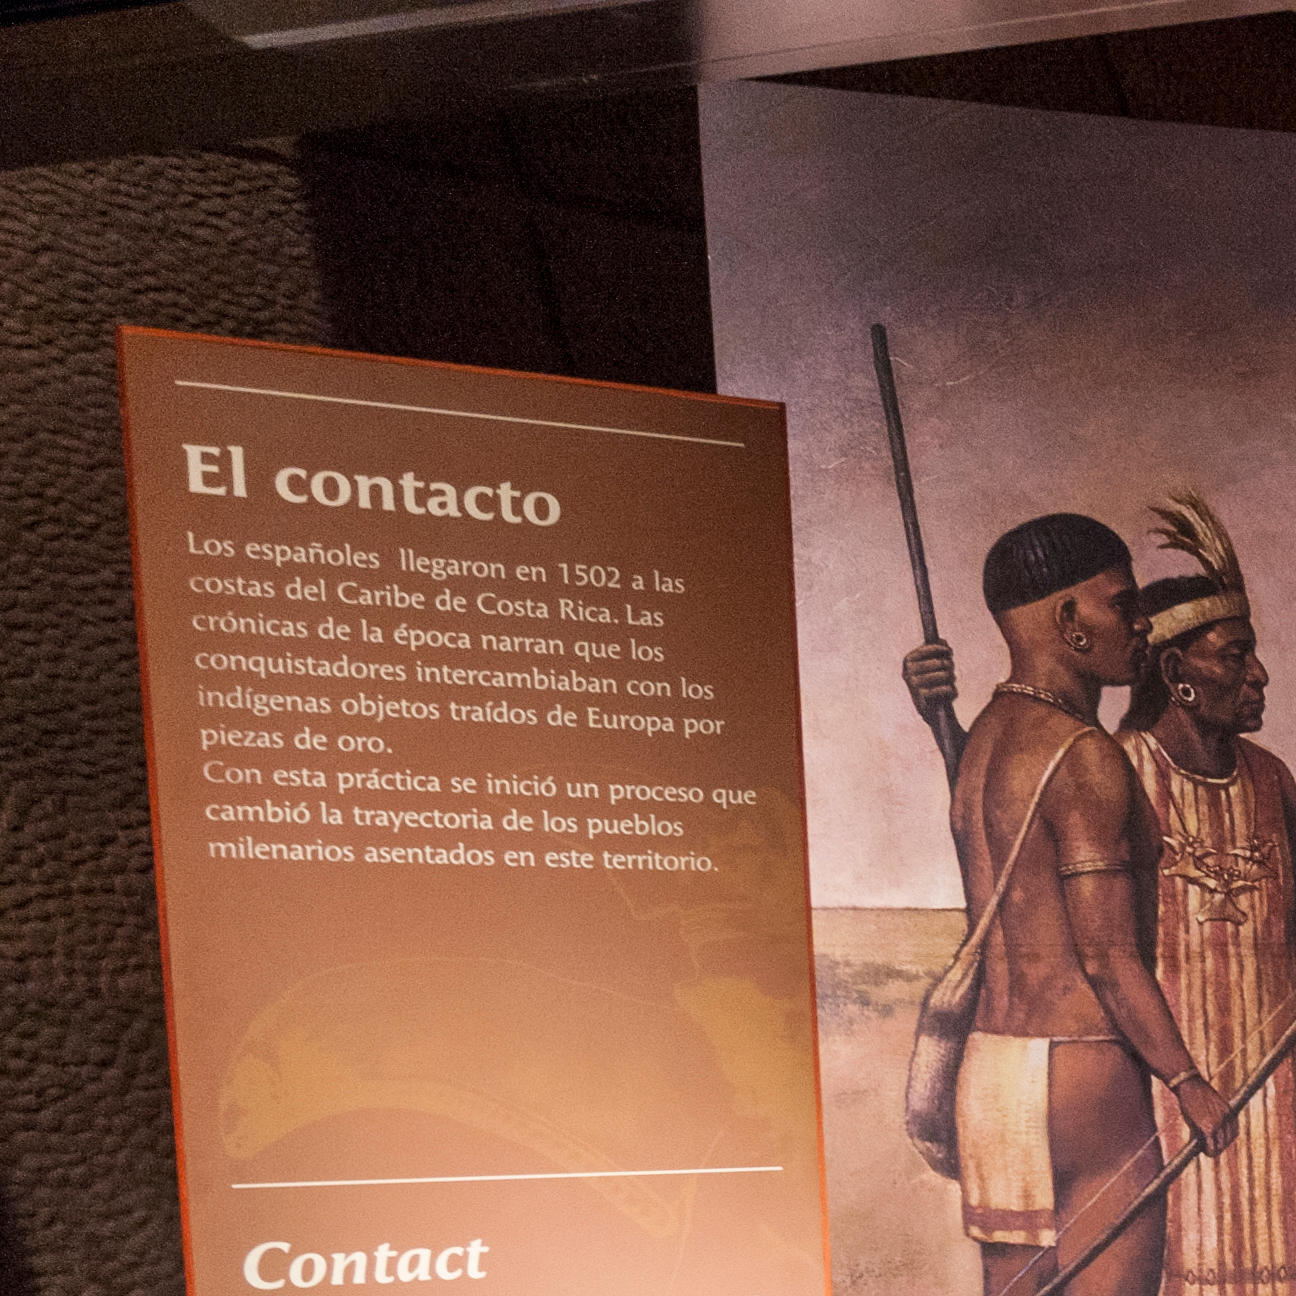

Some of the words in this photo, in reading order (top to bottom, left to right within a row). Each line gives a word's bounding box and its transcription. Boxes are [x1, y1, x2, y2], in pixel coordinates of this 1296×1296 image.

[181, 443, 248, 498] El
[274, 466, 561, 527] contacto
[186, 530, 236, 558] Los
[244, 541, 381, 569] españoles
[399, 547, 506, 581] llegaron
[515, 564, 547, 583] en
[558, 562, 621, 589] 1502
[631, 574, 645, 591] a
[653, 569, 686, 594] las
[189, 576, 276, 599] costas
[284, 576, 327, 602] del
[336, 581, 426, 610] Caribe
[434, 587, 468, 613] de
[476, 592, 550, 619] Costa
[558, 598, 619, 624] Rica.
[625, 603, 665, 628] Las
[191, 610, 309, 639] crónicas
[317, 616, 352, 642] de
[360, 618, 384, 644] la
[393, 622, 472, 652] época
[480, 634, 565, 656] narran
[573, 640, 621, 663] que
[629, 637, 665, 663] los
[194, 651, 407, 682] conquistadores
[415, 660, 618, 694] intercambiaban
[626, 679, 672, 697] con
[680, 676, 715, 701] los
[198, 684, 332, 717] indígenas
[340, 691, 441, 723] objetos
[448, 700, 538, 726] traídos
[546, 703, 578, 728] de
[586, 706, 675, 738] Europa
[682, 717, 726, 739] por
[199, 723, 285, 751] piezas
[293, 725, 328, 751] de
[337, 734, 393, 754] oro.
[202, 760, 262, 785] Con
[272, 767, 327, 788] esta
[336, 767, 442, 795] práctica
[450, 776, 478, 794] se
[486, 772, 558, 798] inició
[565, 782, 600, 799] un
[608, 783, 705, 806] proceso
[711, 788, 757, 810] que
[204, 798, 311, 825] cambió
[319, 800, 344, 826] la
[352, 806, 494, 833] trayectoria
[501, 807, 534, 832] de
[541, 809, 579, 834] los
[586, 812, 684, 840] pueblos
[208, 835, 356, 863] milenarios
[363, 841, 496, 867] asentados
[503, 850, 536, 867] en
[544, 849, 595, 869] este
[602, 849, 719, 872] territorio.
[242, 1238, 490, 1291] Contact
